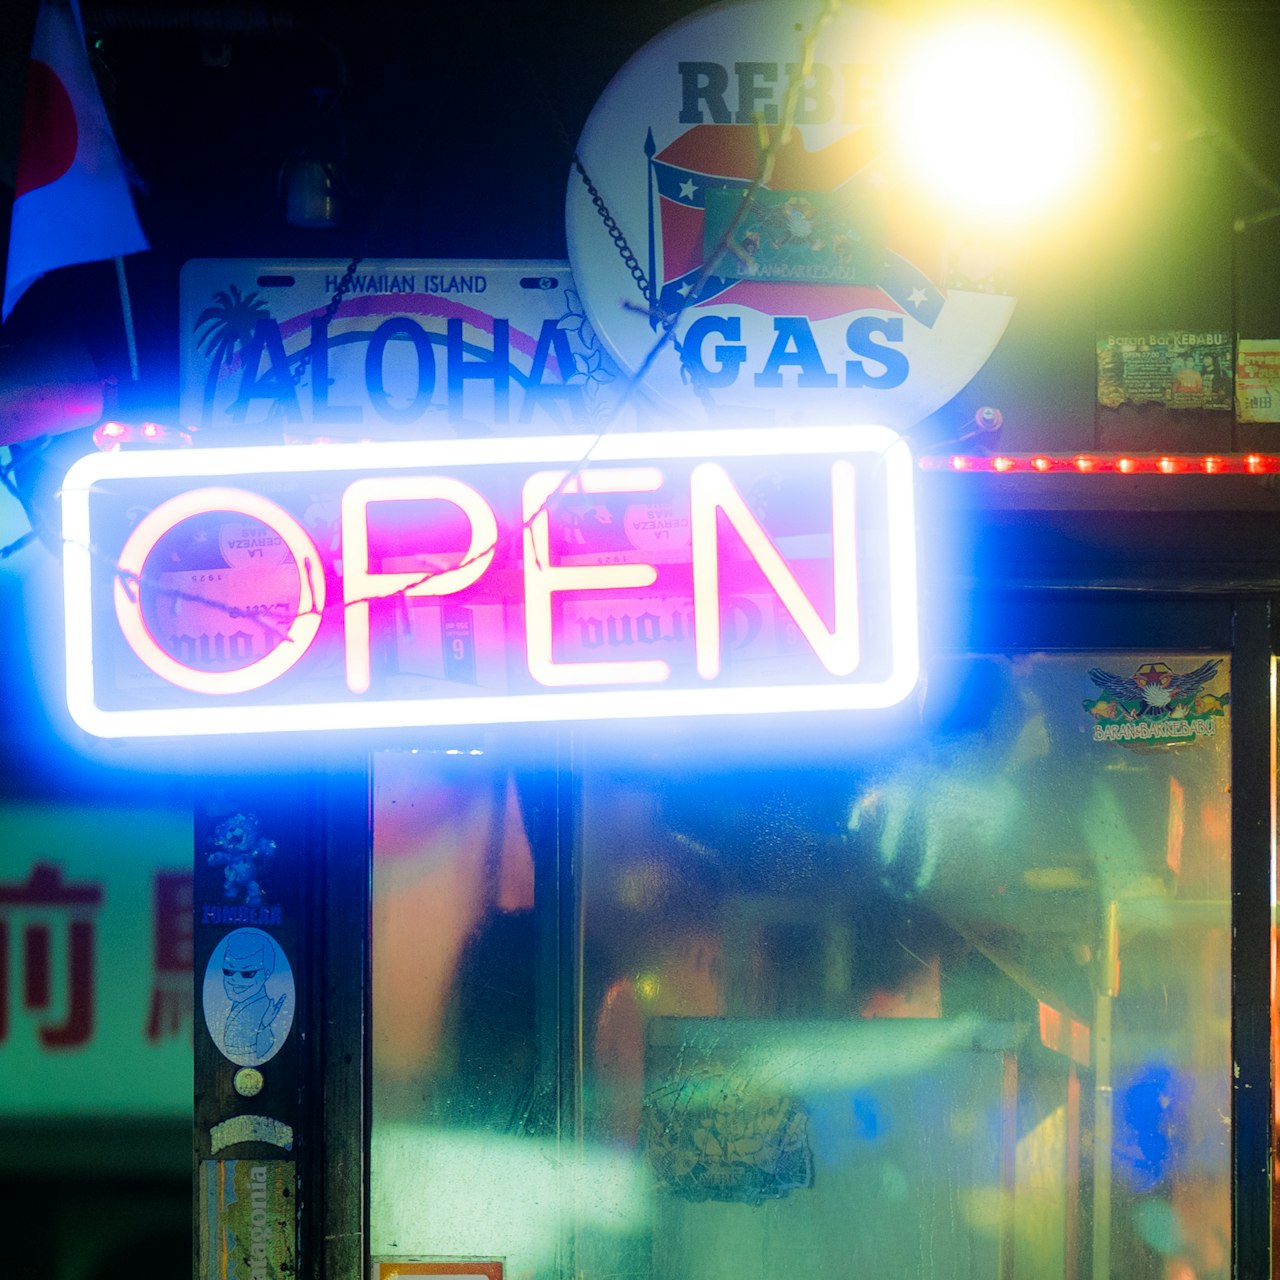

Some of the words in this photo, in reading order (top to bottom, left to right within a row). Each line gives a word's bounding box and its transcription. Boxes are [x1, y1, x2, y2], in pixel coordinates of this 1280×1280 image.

[678, 61, 887, 125] REBE
[324, 274, 417, 294] HAWAIIAN
[422, 274, 488, 294] ISLAND
[233, 314, 586, 426] ALOHA
[684, 315, 910, 390] GAS
[115, 459, 860, 695] OPEN
